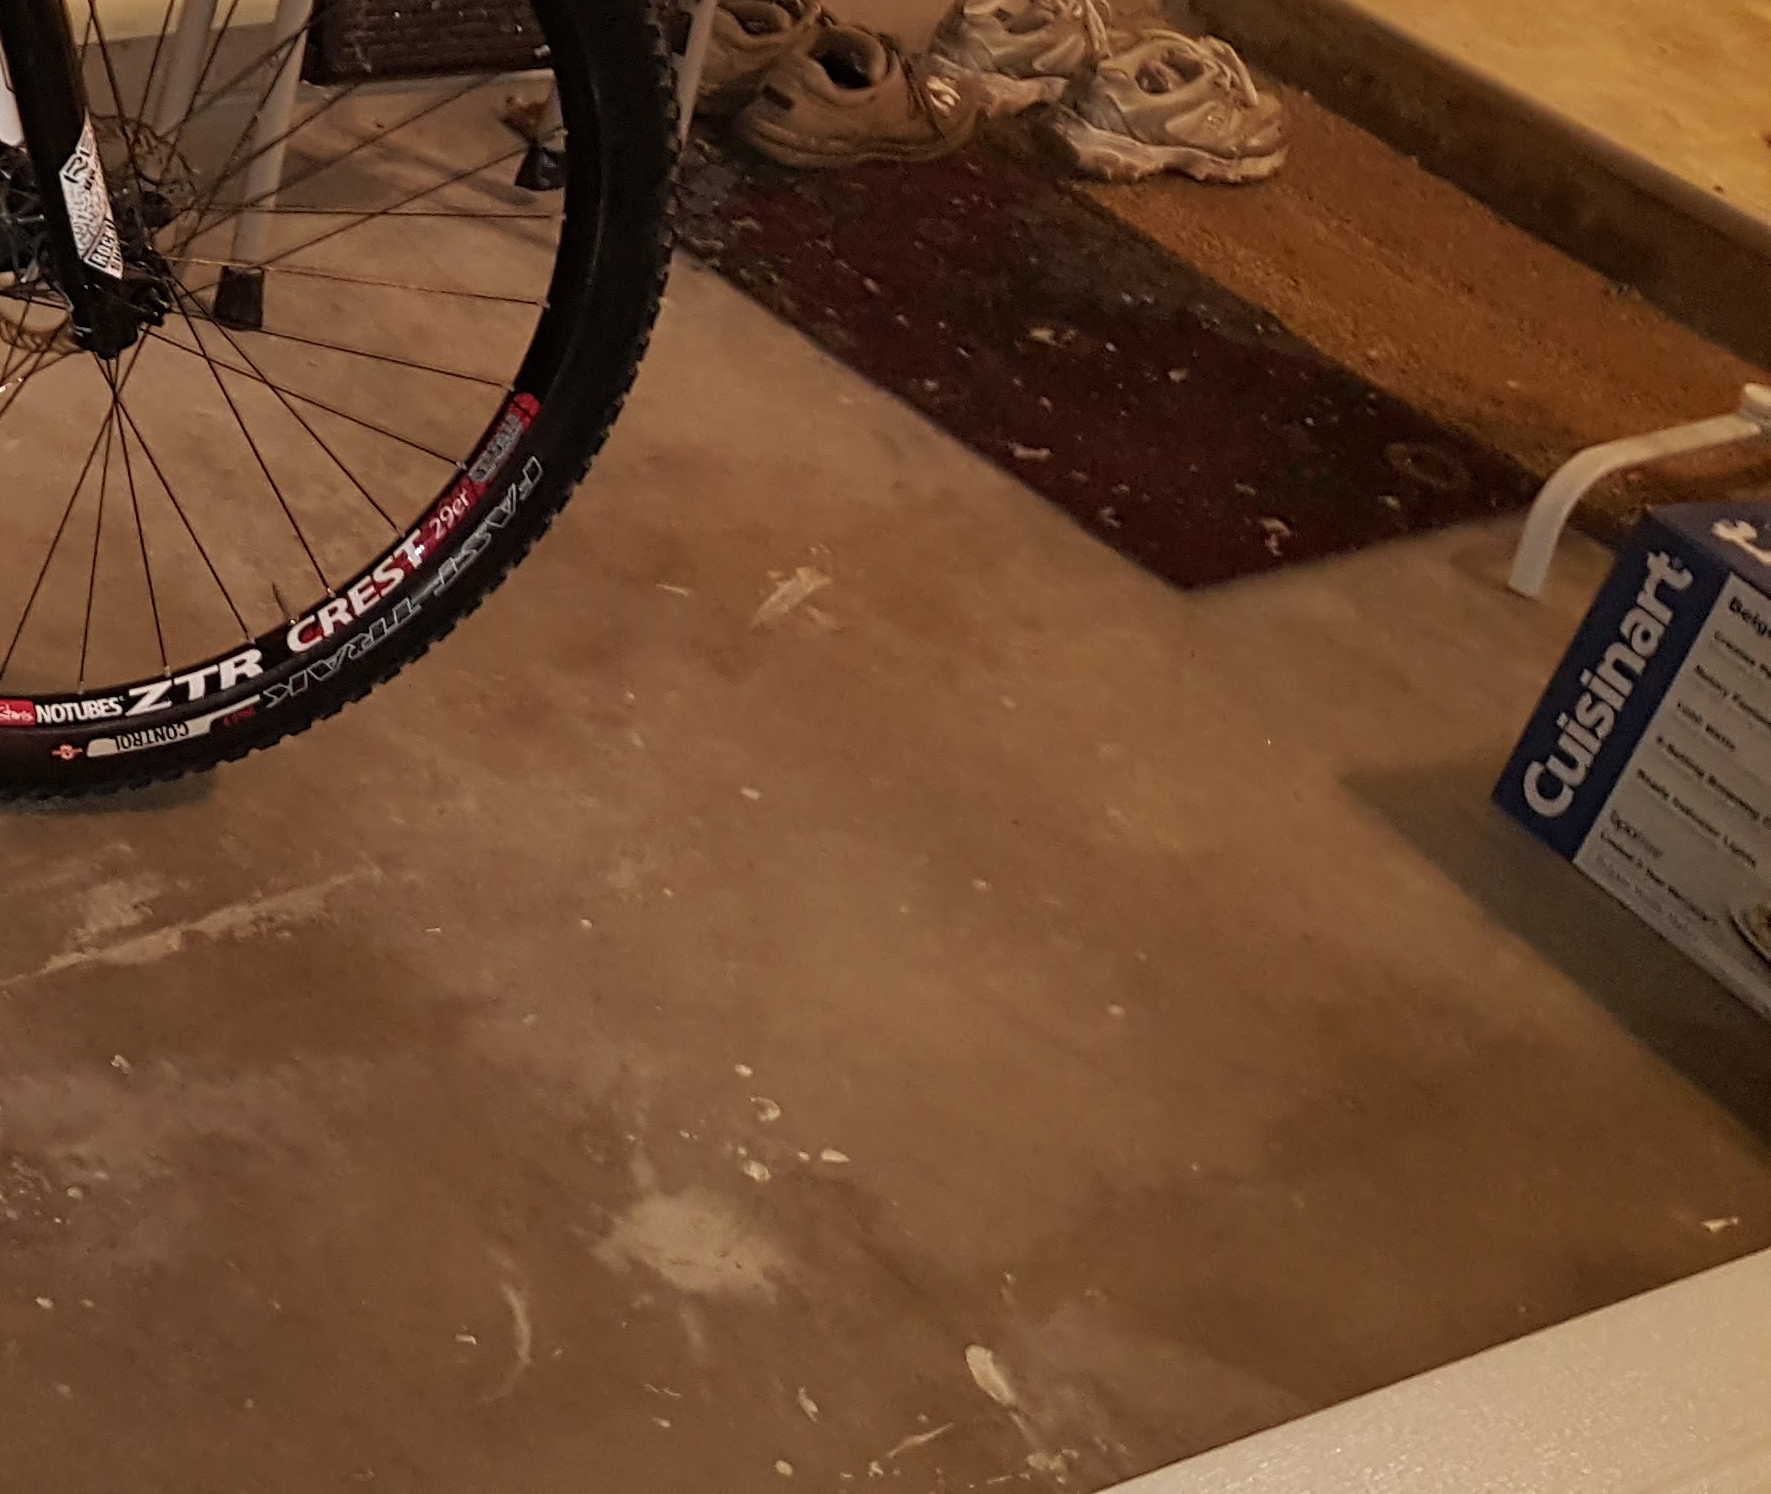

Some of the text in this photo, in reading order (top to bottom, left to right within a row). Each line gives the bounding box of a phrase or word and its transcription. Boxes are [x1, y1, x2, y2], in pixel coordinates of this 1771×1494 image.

[36, 696, 123, 724] NOTUBES
[125, 647, 263, 717] ZTR
[286, 528, 426, 654] CREST
[429, 488, 472, 540] 29er
[1522, 548, 1695, 819] Cuisinart
